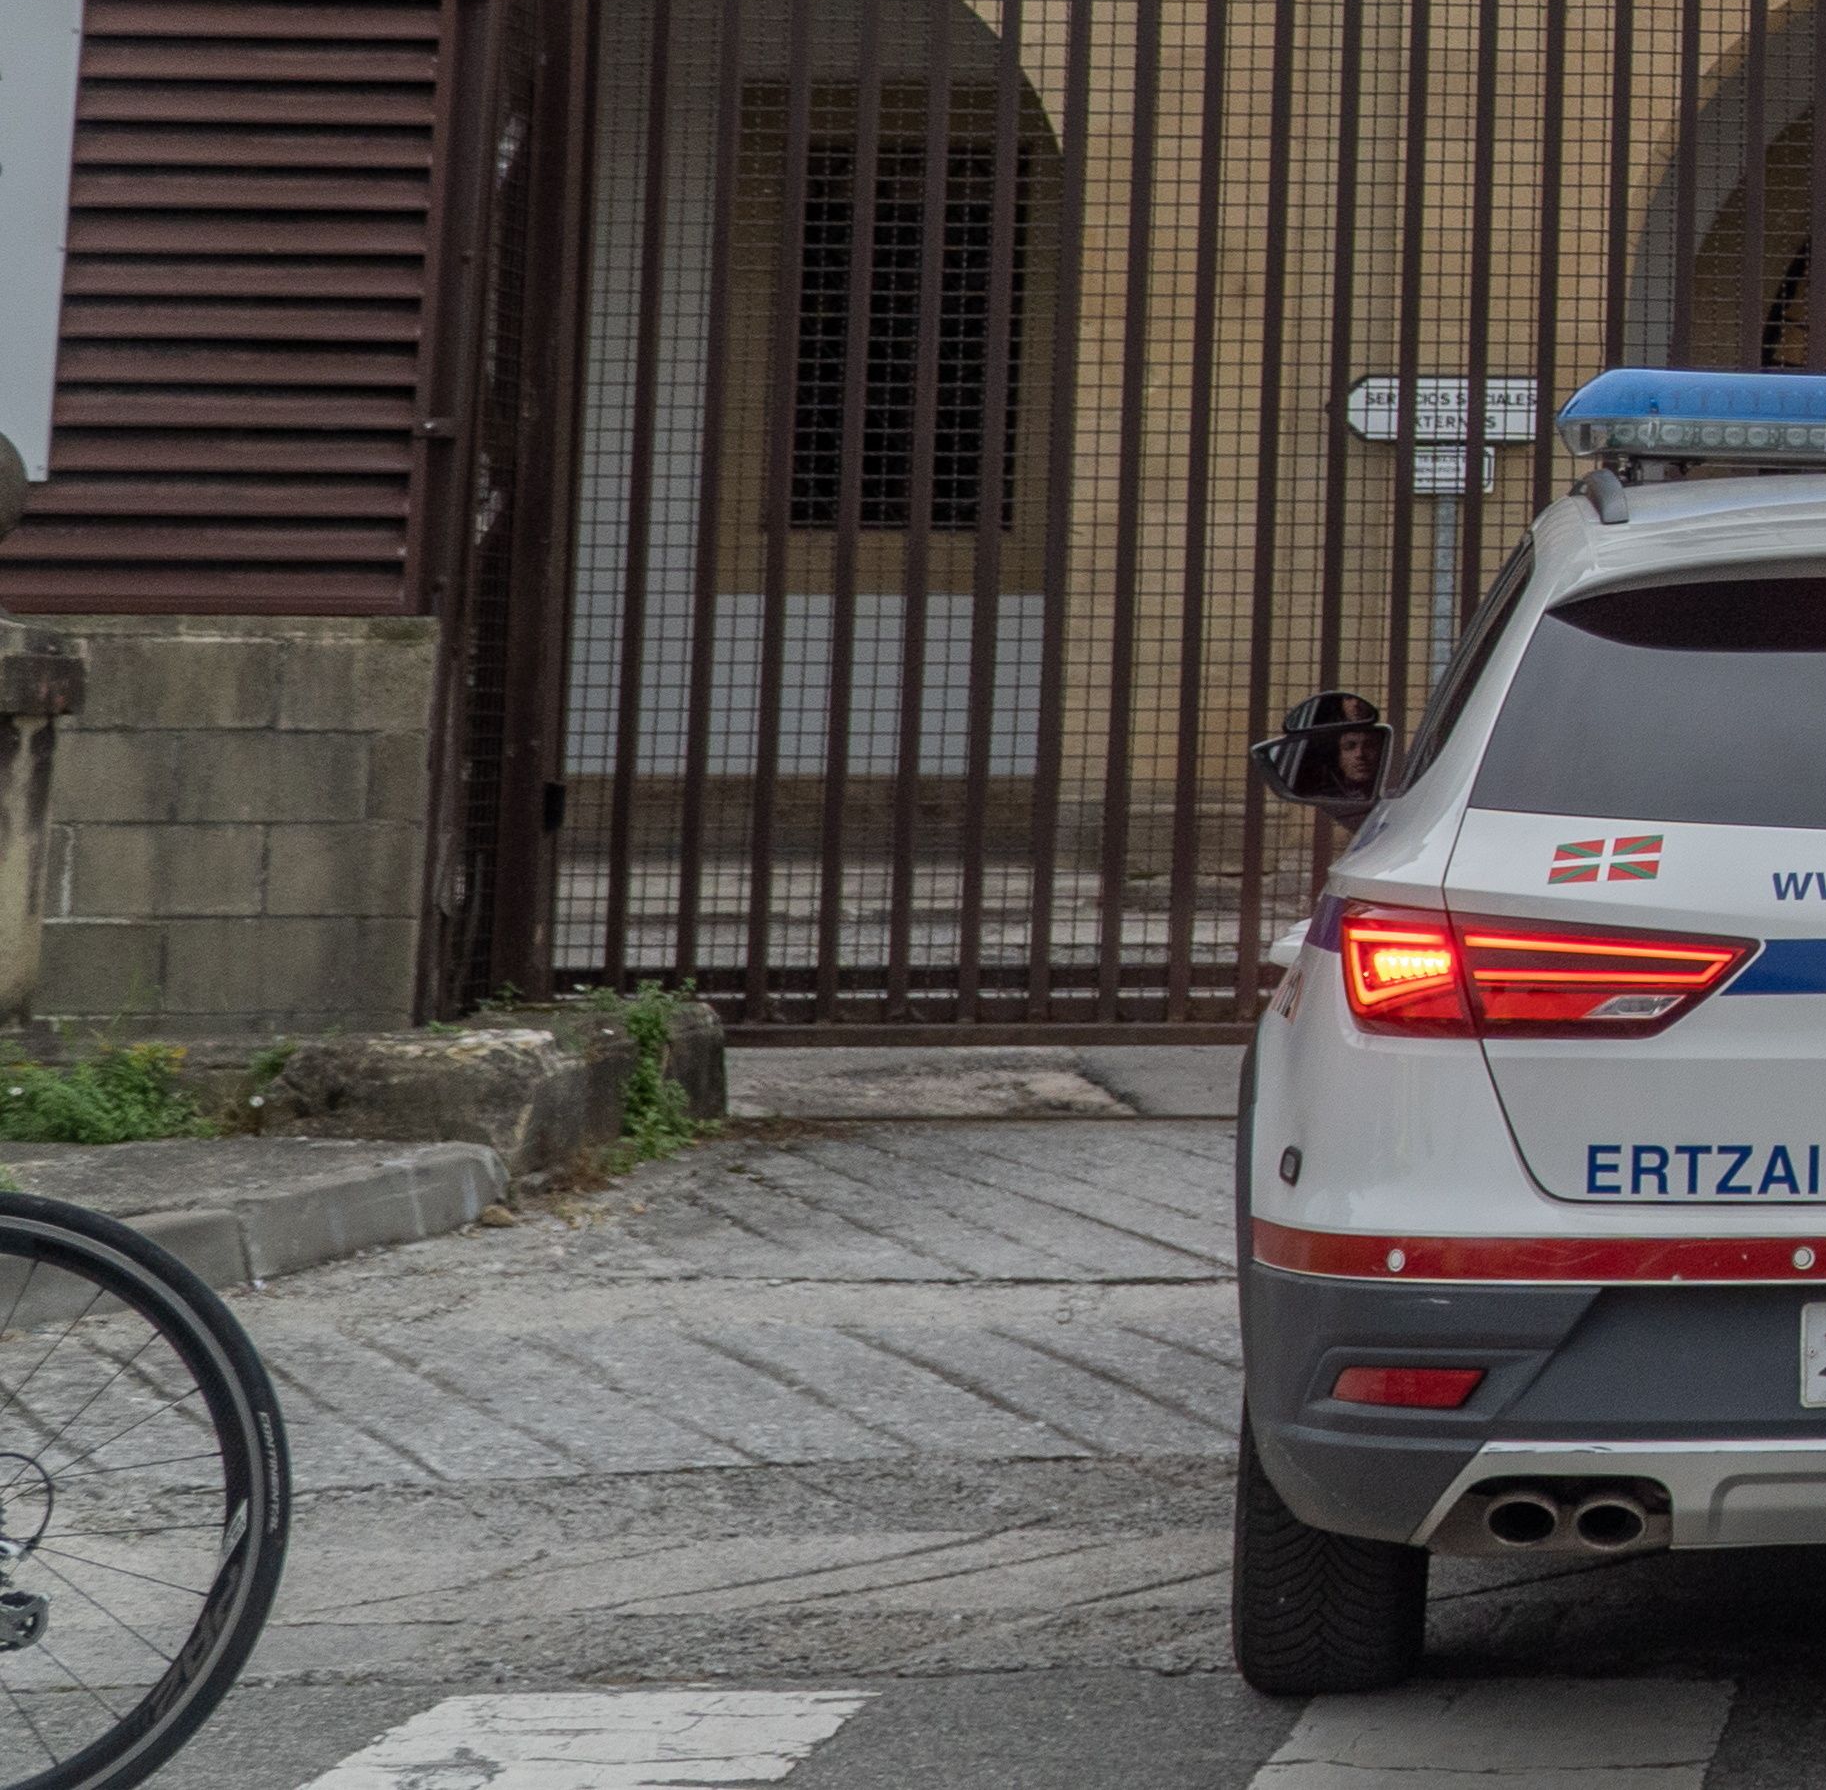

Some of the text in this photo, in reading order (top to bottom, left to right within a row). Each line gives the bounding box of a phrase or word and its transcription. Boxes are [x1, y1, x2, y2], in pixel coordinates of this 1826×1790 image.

[1366, 392, 1537, 406] SERCIOS SCIALES
[1406, 415, 1497, 429] XTERNS
